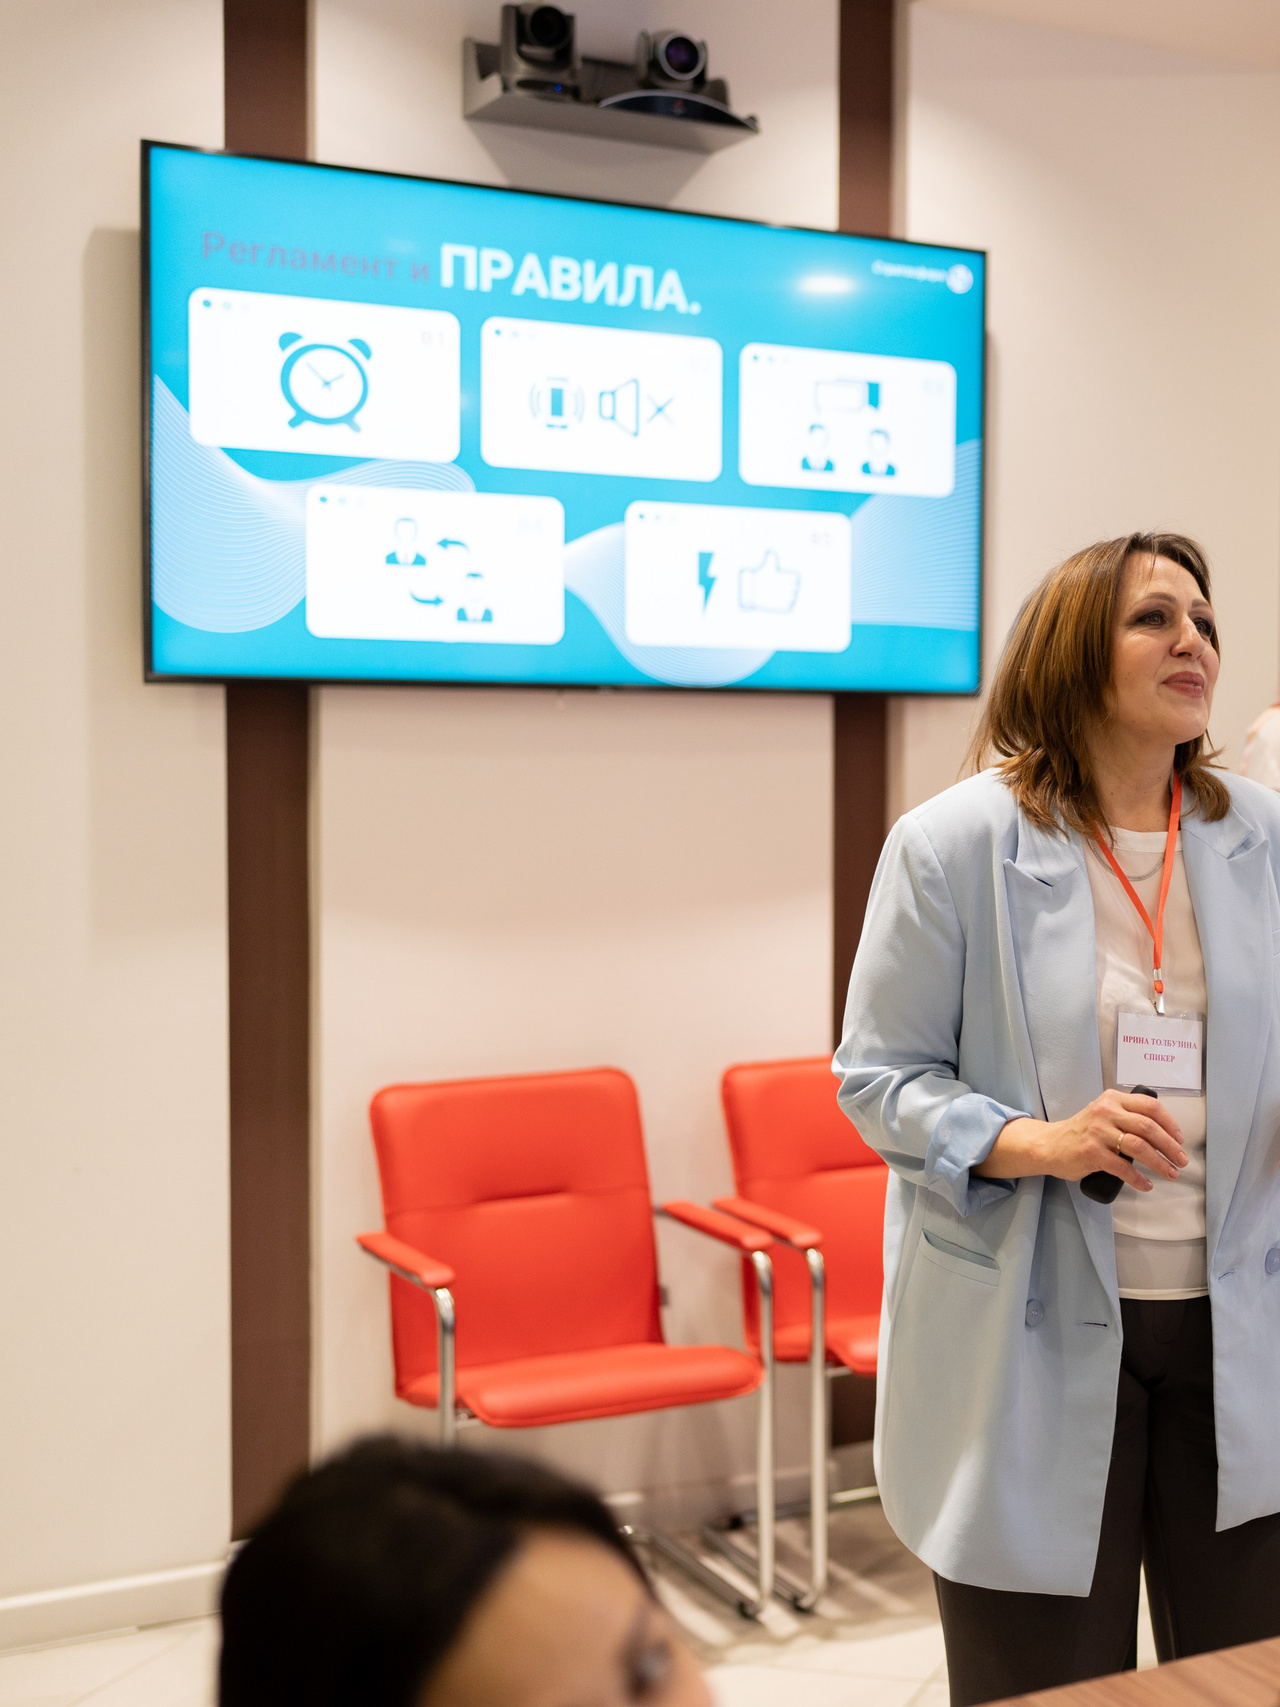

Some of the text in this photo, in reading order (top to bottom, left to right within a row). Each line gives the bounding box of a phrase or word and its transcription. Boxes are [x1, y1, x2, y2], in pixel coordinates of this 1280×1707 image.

[202, 231, 701, 315] Регламент и ПРАВИЛА.
[1122, 1035, 1149, 1045] ИРИНА
[1143, 1052, 1176, 1062] СПИКЕР
